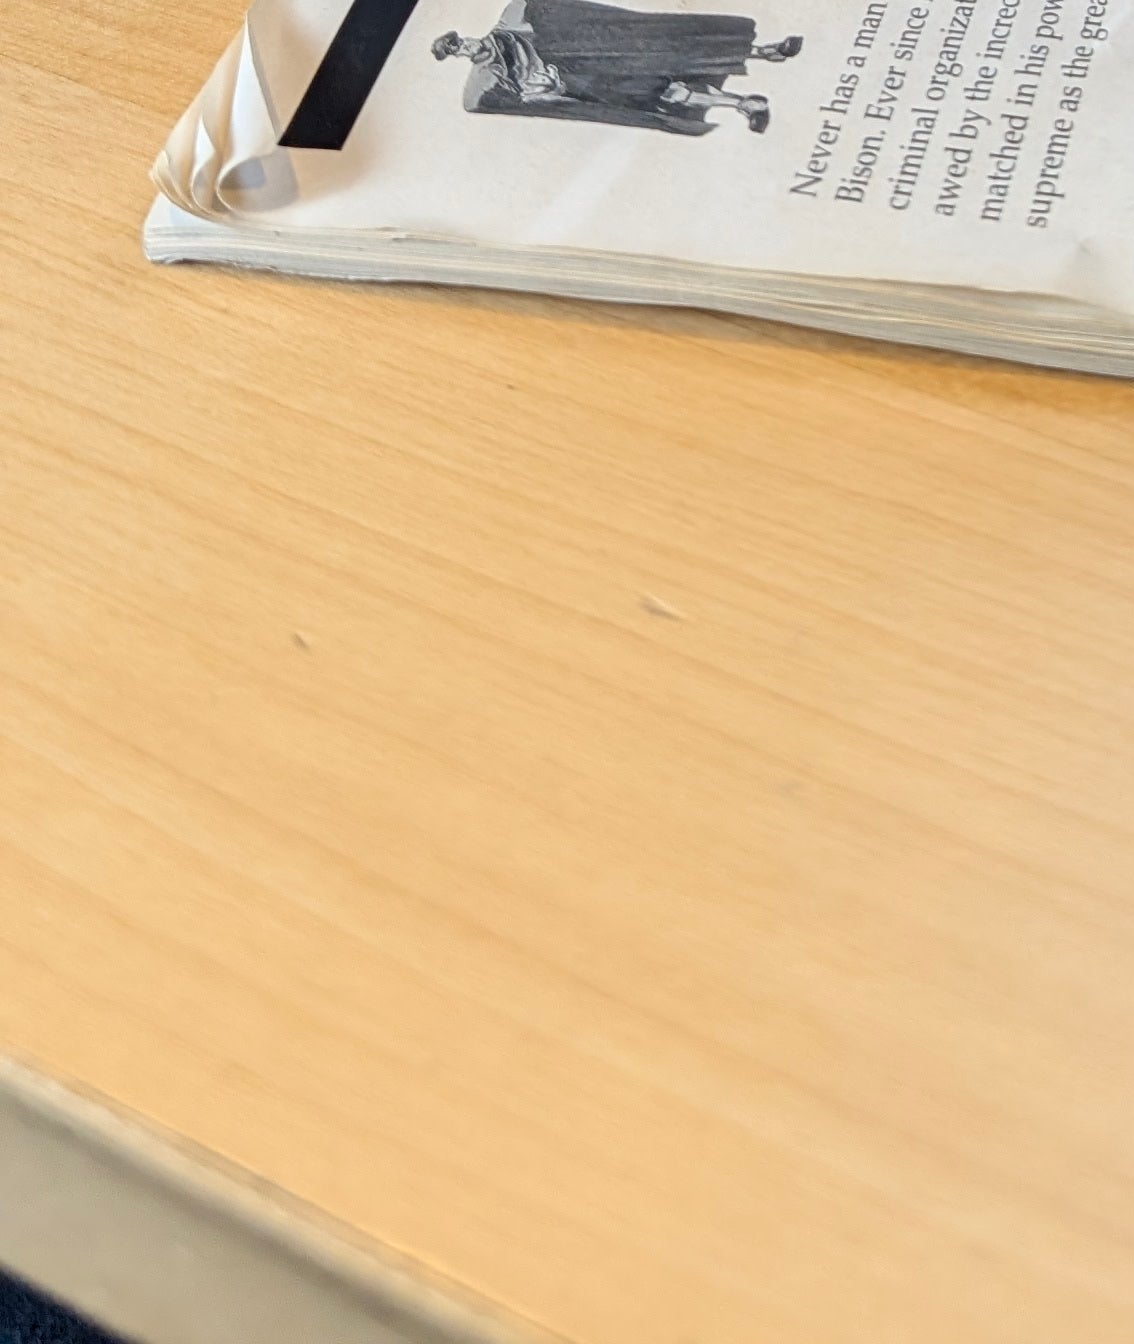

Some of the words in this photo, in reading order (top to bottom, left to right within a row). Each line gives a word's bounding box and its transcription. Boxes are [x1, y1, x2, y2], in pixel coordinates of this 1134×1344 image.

[853, 3, 887, 48] man
[846, 55, 866, 67] a
[819, 73, 858, 114] has
[789, 118, 840, 198] Never
